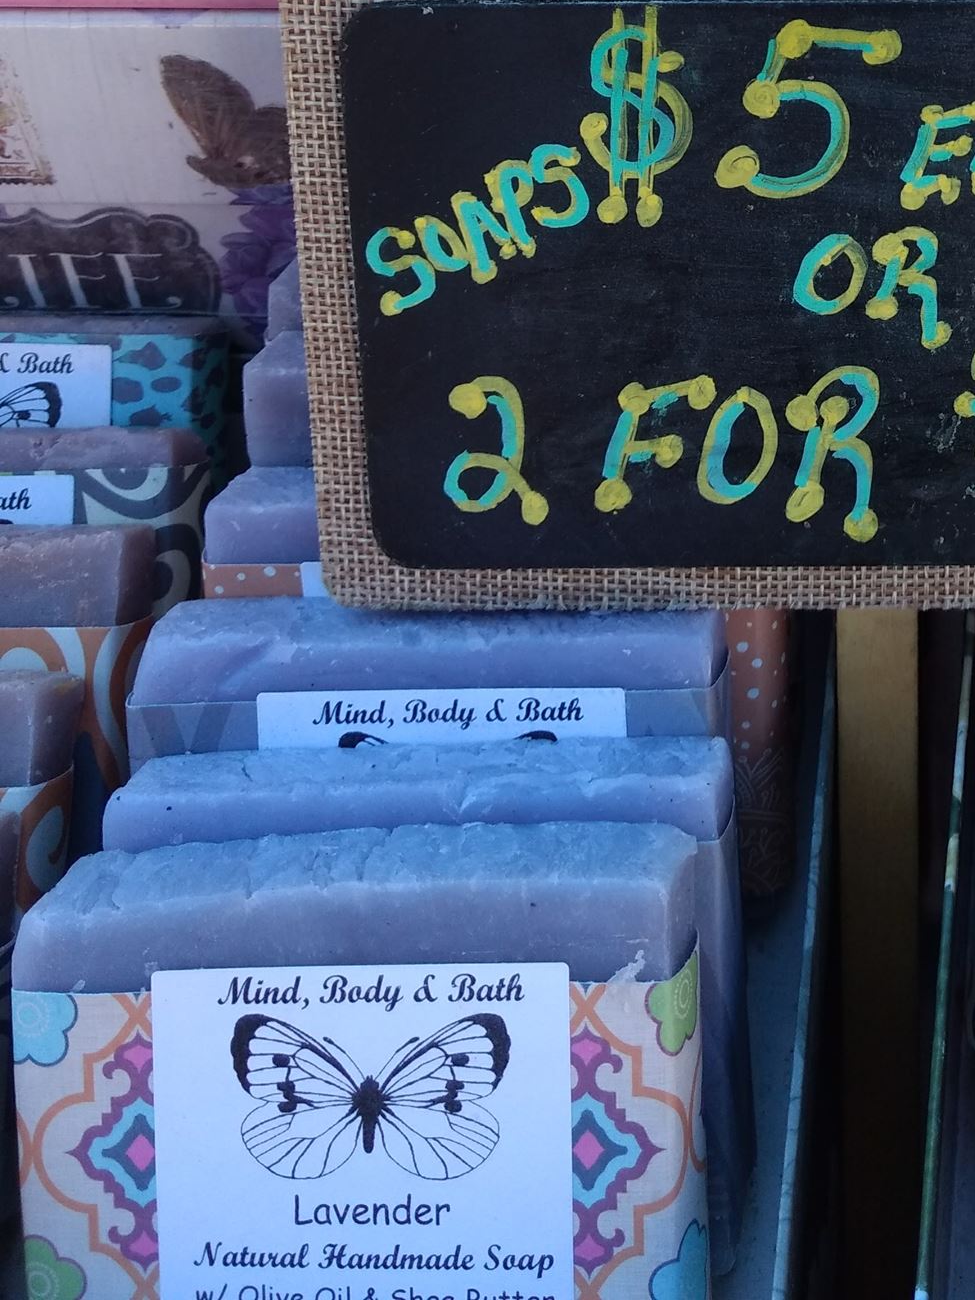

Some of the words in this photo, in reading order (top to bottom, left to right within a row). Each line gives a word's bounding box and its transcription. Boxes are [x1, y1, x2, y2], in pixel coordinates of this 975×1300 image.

[365, 143, 589, 316] SOAPS
[3, 252, 183, 308] IFE
[793, 225, 953, 350] OR
[17, 351, 74, 374] Bath
[443, 376, 549, 526] 2
[594, 365, 881, 542] FOR
[312, 700, 395, 728] Mind,
[402, 699, 477, 730] Body
[485, 698, 508, 723] &
[516, 697, 584, 722] Bath
[217, 975, 310, 1011] Mind,
[319, 974, 404, 1012] Body
[413, 973, 438, 1003] &
[448, 972, 525, 1003] Bath
[293, 1193, 451, 1226] Lavender
[193, 1241, 310, 1268] Natural
[318, 1243, 475, 1271] Handmade
[483, 1244, 554, 1279] Soap
